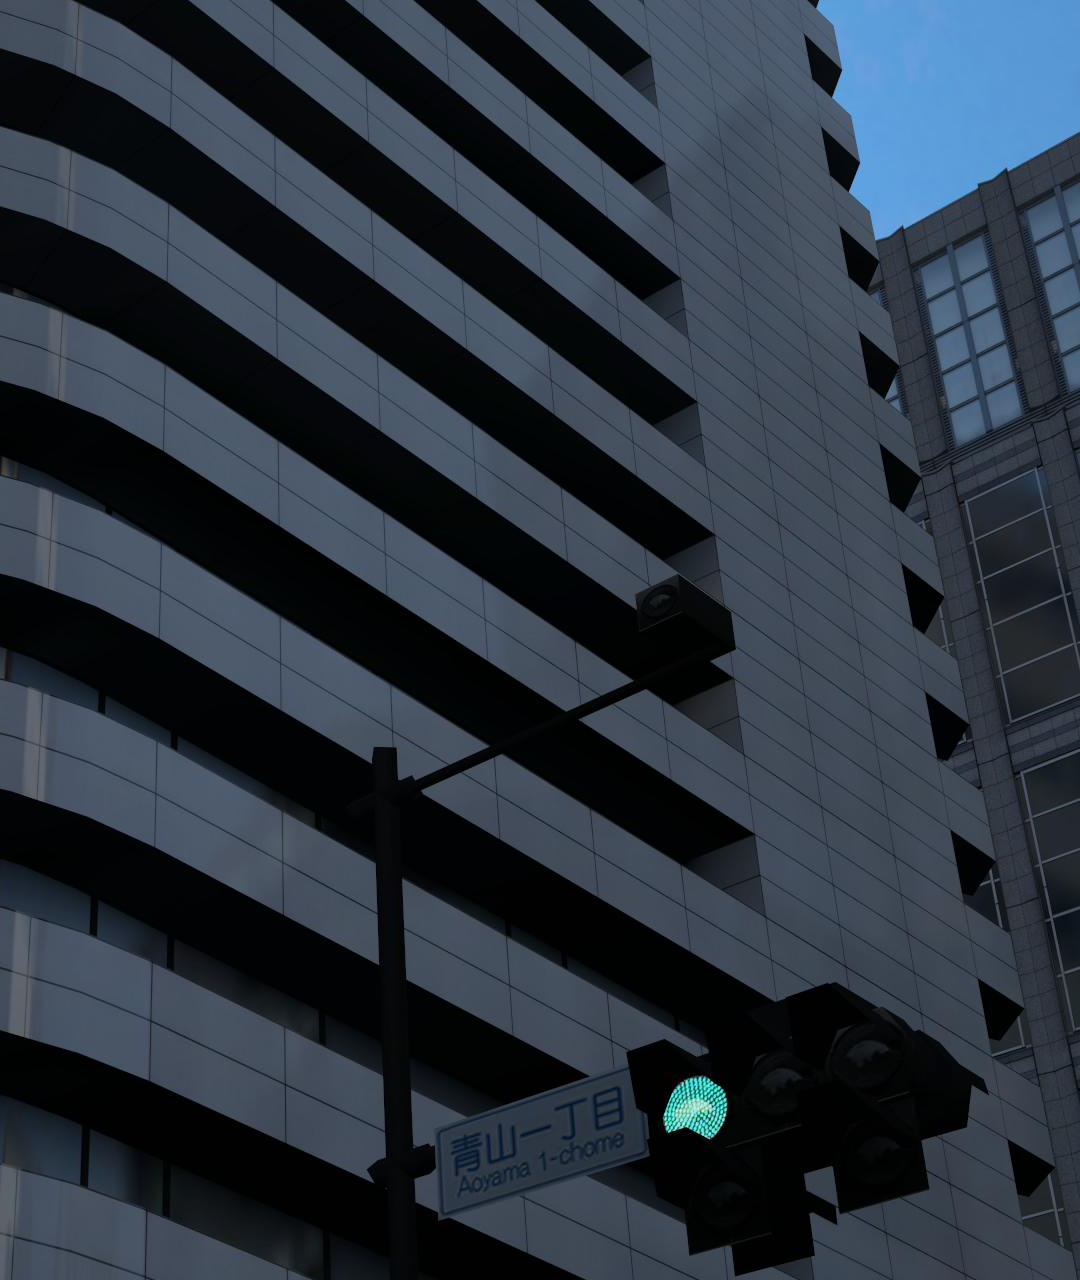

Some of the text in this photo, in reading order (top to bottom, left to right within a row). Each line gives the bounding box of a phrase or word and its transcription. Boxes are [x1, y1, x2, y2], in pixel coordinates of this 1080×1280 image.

[450, 1086, 624, 1177] 青山一丁目
[457, 1131, 625, 1198] Aoyama 1-chome
